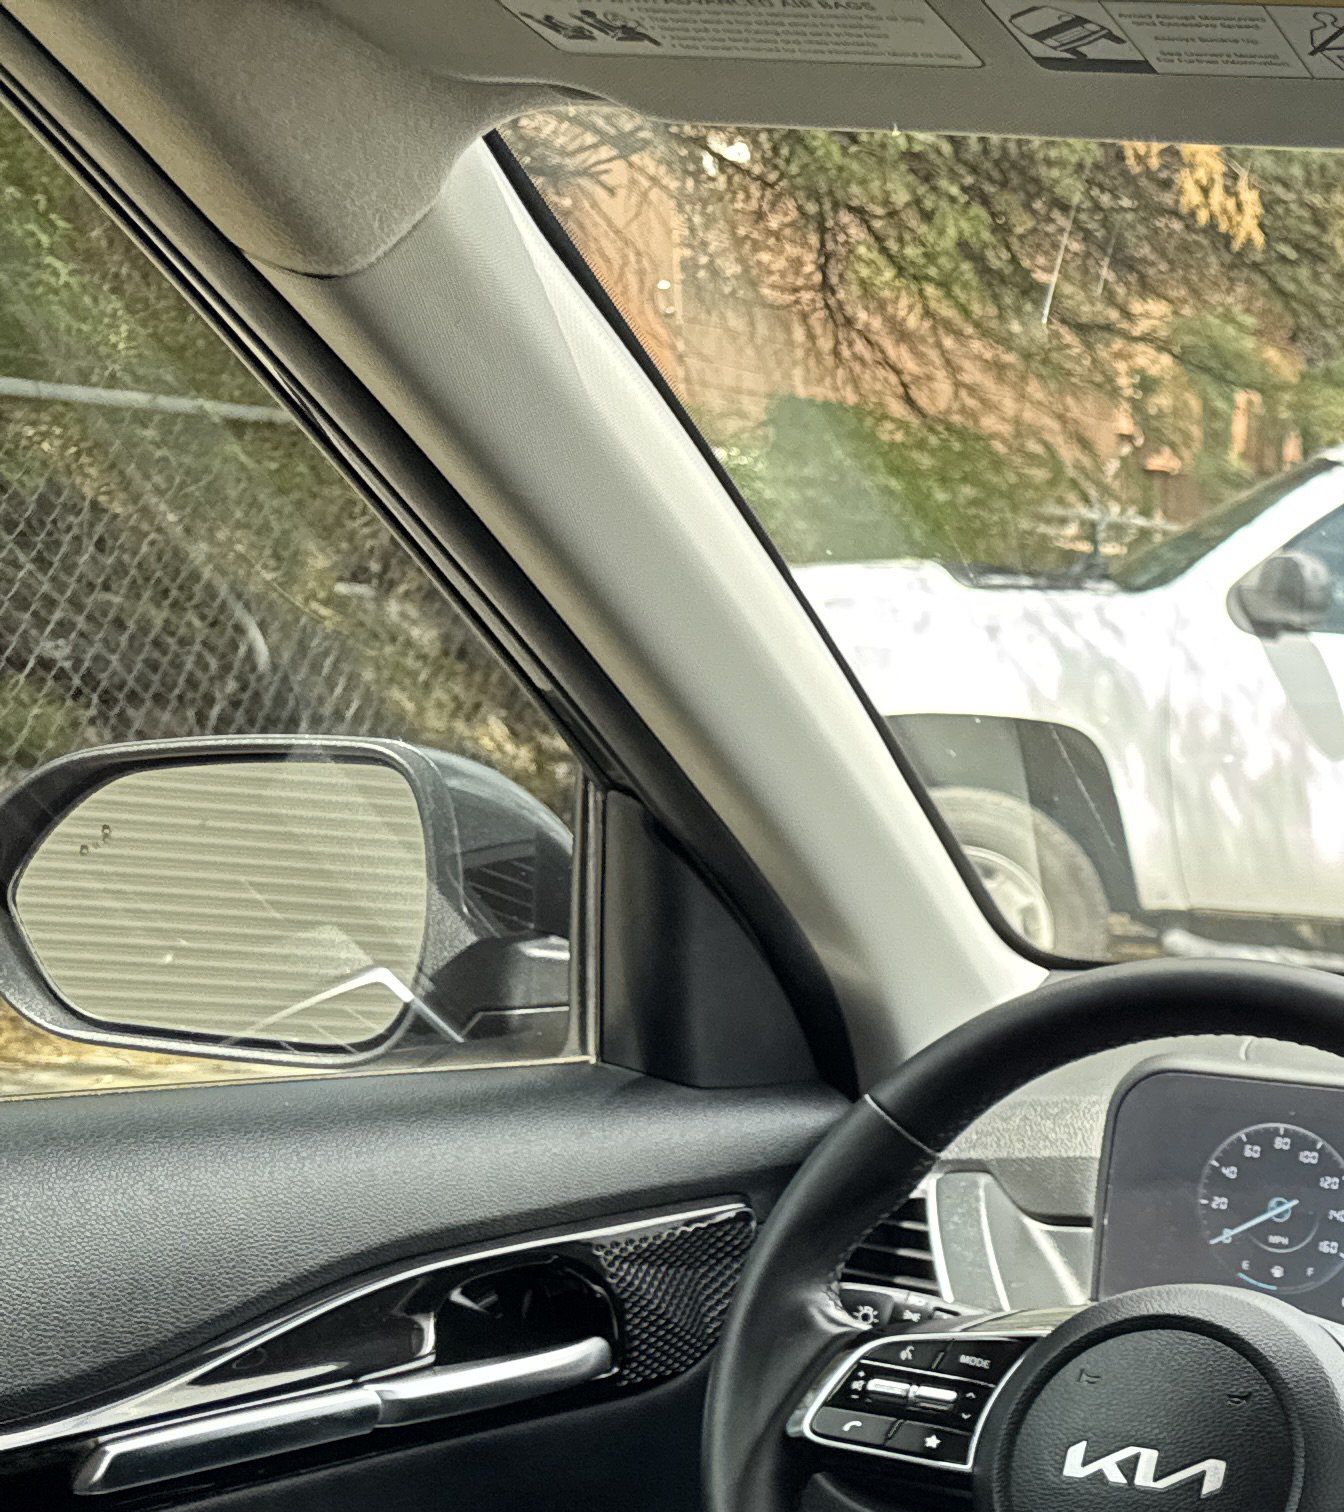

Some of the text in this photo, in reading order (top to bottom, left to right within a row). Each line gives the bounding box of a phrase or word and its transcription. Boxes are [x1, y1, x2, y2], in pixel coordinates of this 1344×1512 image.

[1273, 1136, 1291, 1150] 80
[1211, 1196, 1229, 1210] 20
[959, 1354, 991, 1370] MODE
[1062, 1440, 1227, 1496] KIA
